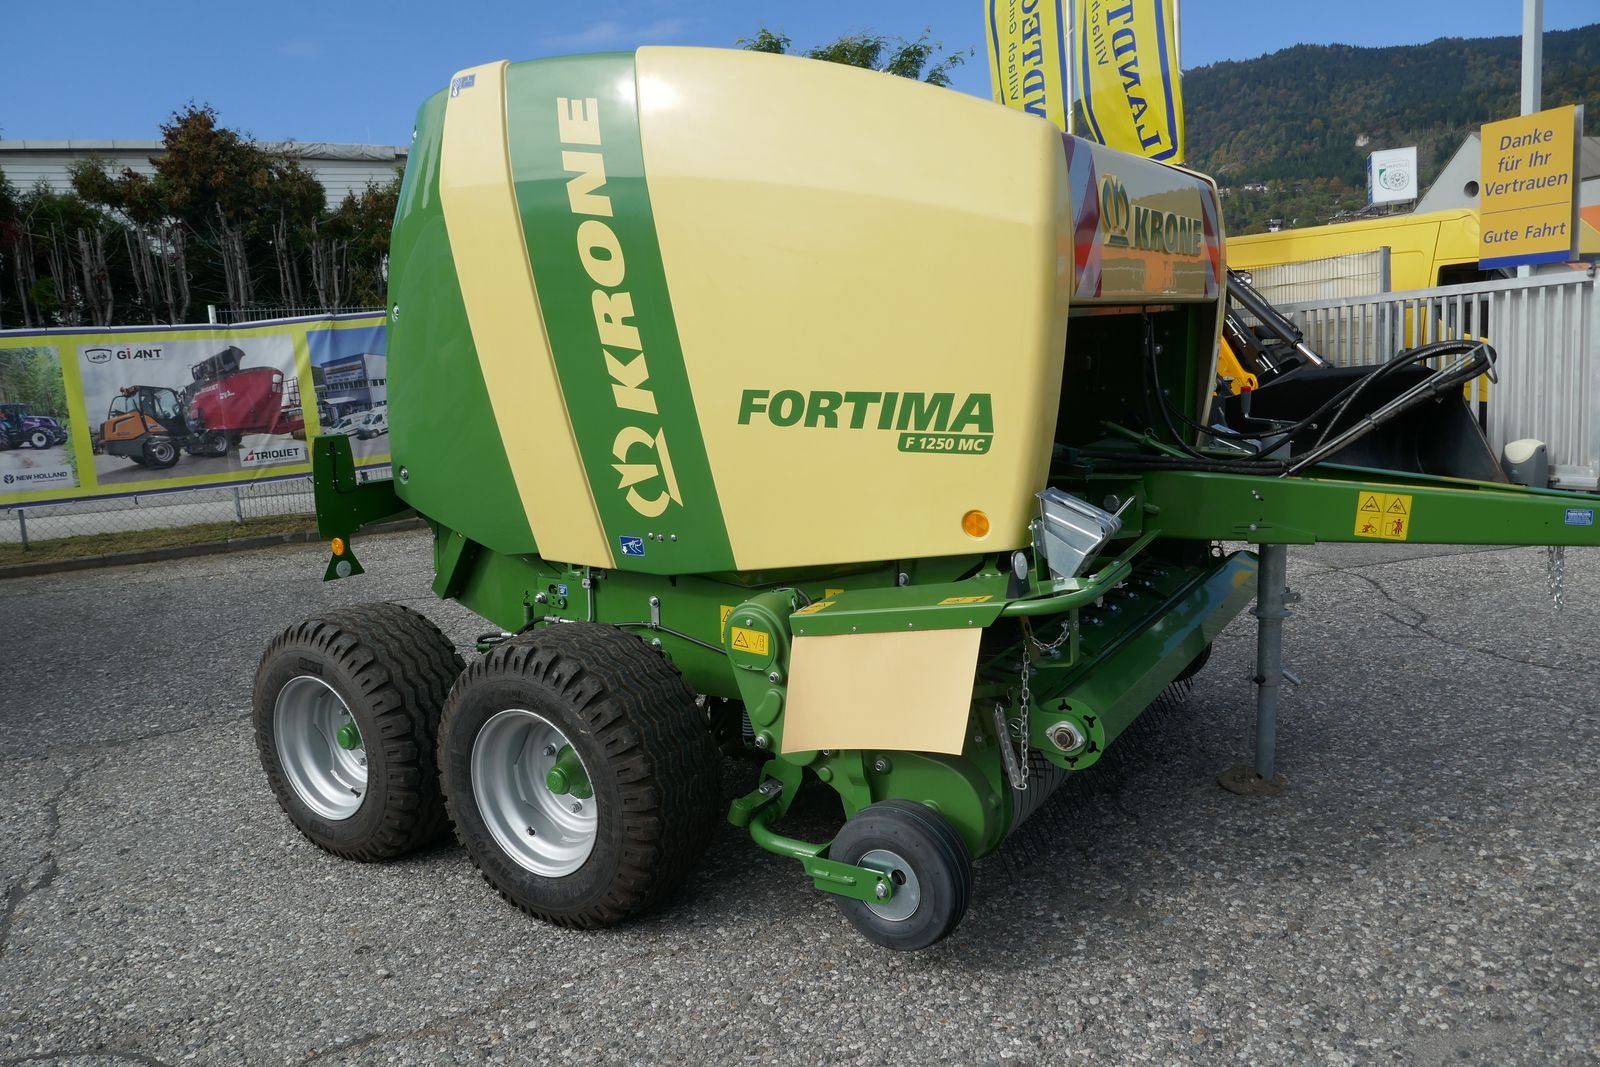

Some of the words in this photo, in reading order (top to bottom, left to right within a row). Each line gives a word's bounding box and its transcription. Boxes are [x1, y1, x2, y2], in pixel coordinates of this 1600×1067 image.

[1499, 128, 1554, 151] Danke
[1497, 157, 1523, 174] für
[1528, 151, 1552, 168] Ihr
[1484, 172, 1568, 197] Vertrauen
[1132, 205, 1203, 257] KRONE
[1483, 228, 1519, 244] Gute
[1524, 221, 1566, 239] Fahrt
[556, 97, 659, 415] KRONE
[737, 388, 994, 433] FORTIMA
[254, 447, 299, 461] TRIOLIET
[905, 437, 916, 449] F
[919, 437, 955, 451] 1250
[958, 438, 985, 452] MC
[33, 471, 68, 480] HOLLAND
